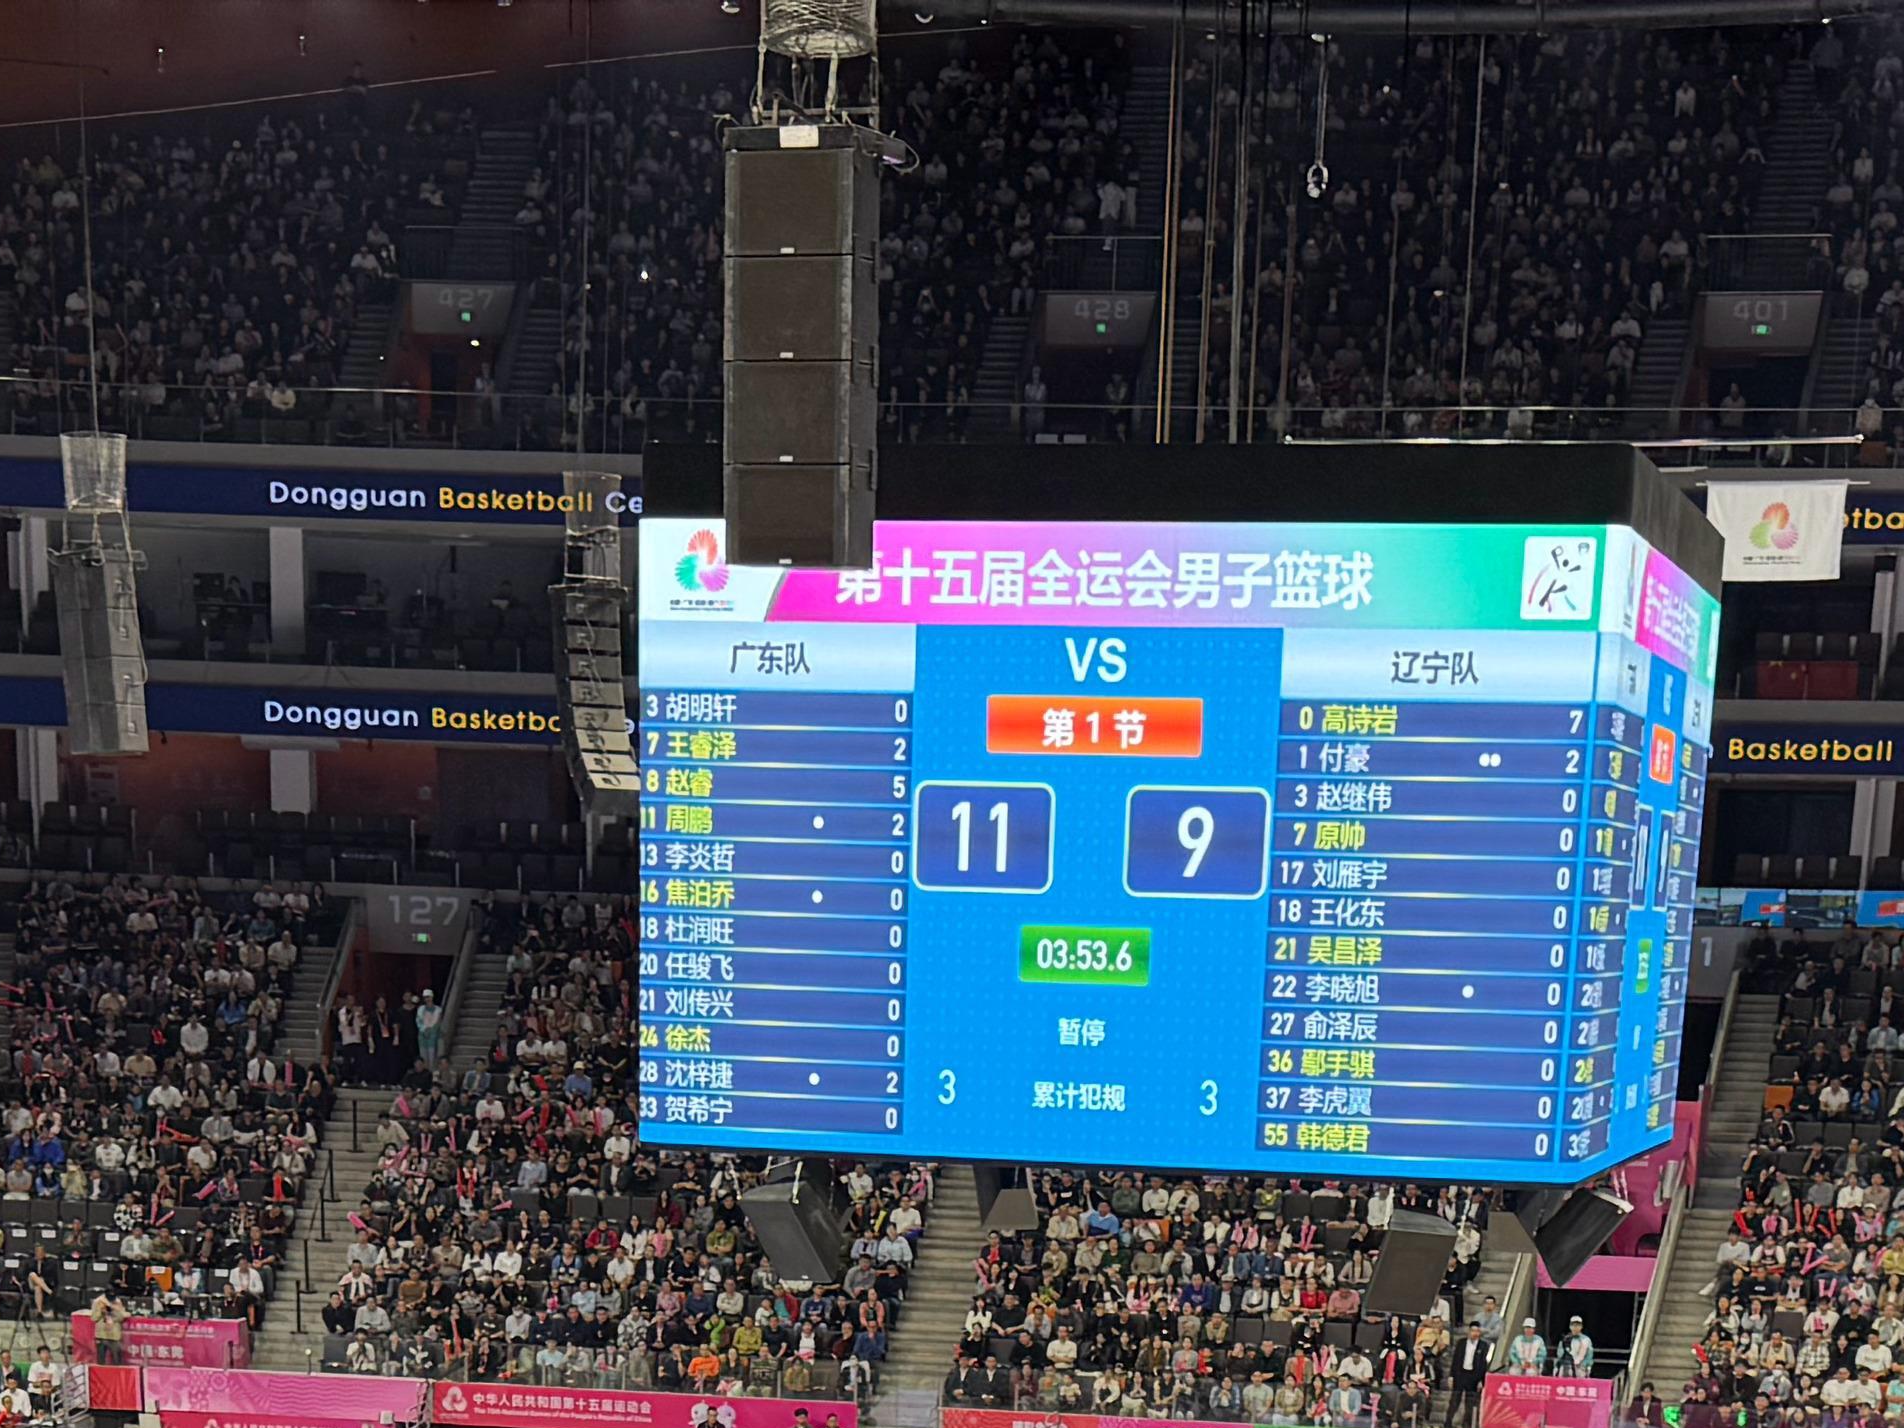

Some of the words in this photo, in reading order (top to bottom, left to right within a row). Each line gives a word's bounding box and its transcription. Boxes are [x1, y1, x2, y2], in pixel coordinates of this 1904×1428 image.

[438, 289, 492, 309] 427
[1075, 300, 1127, 319] 428
[1733, 300, 1788, 320] 401
[269, 481, 426, 511] Dongguan
[439, 487, 593, 513] Basketball
[835, 548, 1373, 611] 第十五届全运会男子篮球
[730, 642, 810, 675] 广东队
[1065, 638, 1127, 682] VS
[1391, 650, 1479, 685] 辽宁队
[264, 701, 419, 730] Dongguan
[646, 695, 658, 717] 3
[665, 693, 737, 722] 胡明轩
[895, 700, 907, 722] 0
[1299, 706, 1313, 730] 0
[1321, 704, 1398, 735] 高诗岩
[1569, 710, 1583, 734] 7
[647, 732, 659, 756] 7
[666, 731, 737, 760] 王睿泽
[894, 738, 906, 760] 2
[1299, 745, 1308, 768] 1
[1319, 743, 1370, 773] 付豪
[1565, 750, 1579, 773] 2
[1728, 738, 1894, 763] Basketball
[646, 770, 659, 792] 8
[665, 768, 713, 797] 赵睿
[893, 776, 905, 798] 5
[1295, 784, 1308, 807] 3
[1316, 782, 1392, 812] 赵继伟
[1562, 789, 1577, 813] 0
[641, 806, 656, 828] 11
[666, 804, 713, 833] 周鹏
[892, 814, 904, 836] 2
[1293, 823, 1307, 846] 7
[1314, 821, 1365, 850] 原帅
[1559, 828, 1574, 851] 0
[952, 801, 1009, 872] 11
[1178, 806, 1214, 878] 9
[641, 844, 658, 866] 13
[665, 842, 735, 872] 李炎哲
[891, 851, 904, 873] 0
[1281, 861, 1304, 884] 17
[1312, 859, 1388, 889] 刘雁宇
[1556, 867, 1570, 891] 0
[387, 895, 458, 926] 127
[641, 881, 659, 903] 16
[665, 879, 735, 908] 焦泊乔
[890, 888, 903, 910] 0
[1279, 899, 1301, 923] 18
[1309, 898, 1386, 928] 王化东
[1553, 906, 1567, 929] 0
[641, 917, 658, 938] 18
[665, 915, 734, 944] 杜润旺
[889, 925, 902, 948] 0
[640, 954, 658, 975] 20
[665, 952, 734, 981] 任骏飞
[888, 962, 901, 984] 0
[1037, 939, 1132, 971] 03:53.6
[1274, 937, 1297, 961] 21
[1307, 936, 1383, 966] 吴昌泽
[1550, 944, 1564, 968] 0
[640, 990, 655, 1012] 21
[665, 988, 734, 1017] 刘传兴
[888, 999, 900, 1021] 0
[1272, 975, 1297, 998] 22
[1305, 973, 1380, 1003] 李晓旭
[1547, 982, 1561, 1006] 0
[640, 1025, 658, 1047] 24
[665, 1023, 711, 1052] 徐杰
[887, 1035, 899, 1057] 0
[1058, 1018, 1106, 1046] 暂停
[1270, 1013, 1295, 1036] 27
[1303, 1011, 1378, 1041] 俞泽辰
[1544, 1020, 1558, 1044] 0
[640, 1061, 658, 1083] 28
[665, 1059, 733, 1089] 沈梓捷
[886, 1072, 898, 1094] 2
[1267, 1050, 1293, 1073] 36
[1541, 1058, 1554, 1082] 0
[938, 1069, 956, 1105] 3
[1032, 1082, 1126, 1112] 累计犯规
[1200, 1079, 1218, 1116] 3
[1265, 1087, 1291, 1110] 37
[1298, 1086, 1372, 1116] 李虎翼
[1537, 1096, 1552, 1120] 0
[640, 1097, 657, 1118] 33
[665, 1095, 733, 1125] 贺希宁
[885, 1107, 897, 1129] 0
[1263, 1124, 1289, 1146] 55
[1296, 1122, 1371, 1153] 韩德君
[1534, 1134, 1549, 1156] 0
